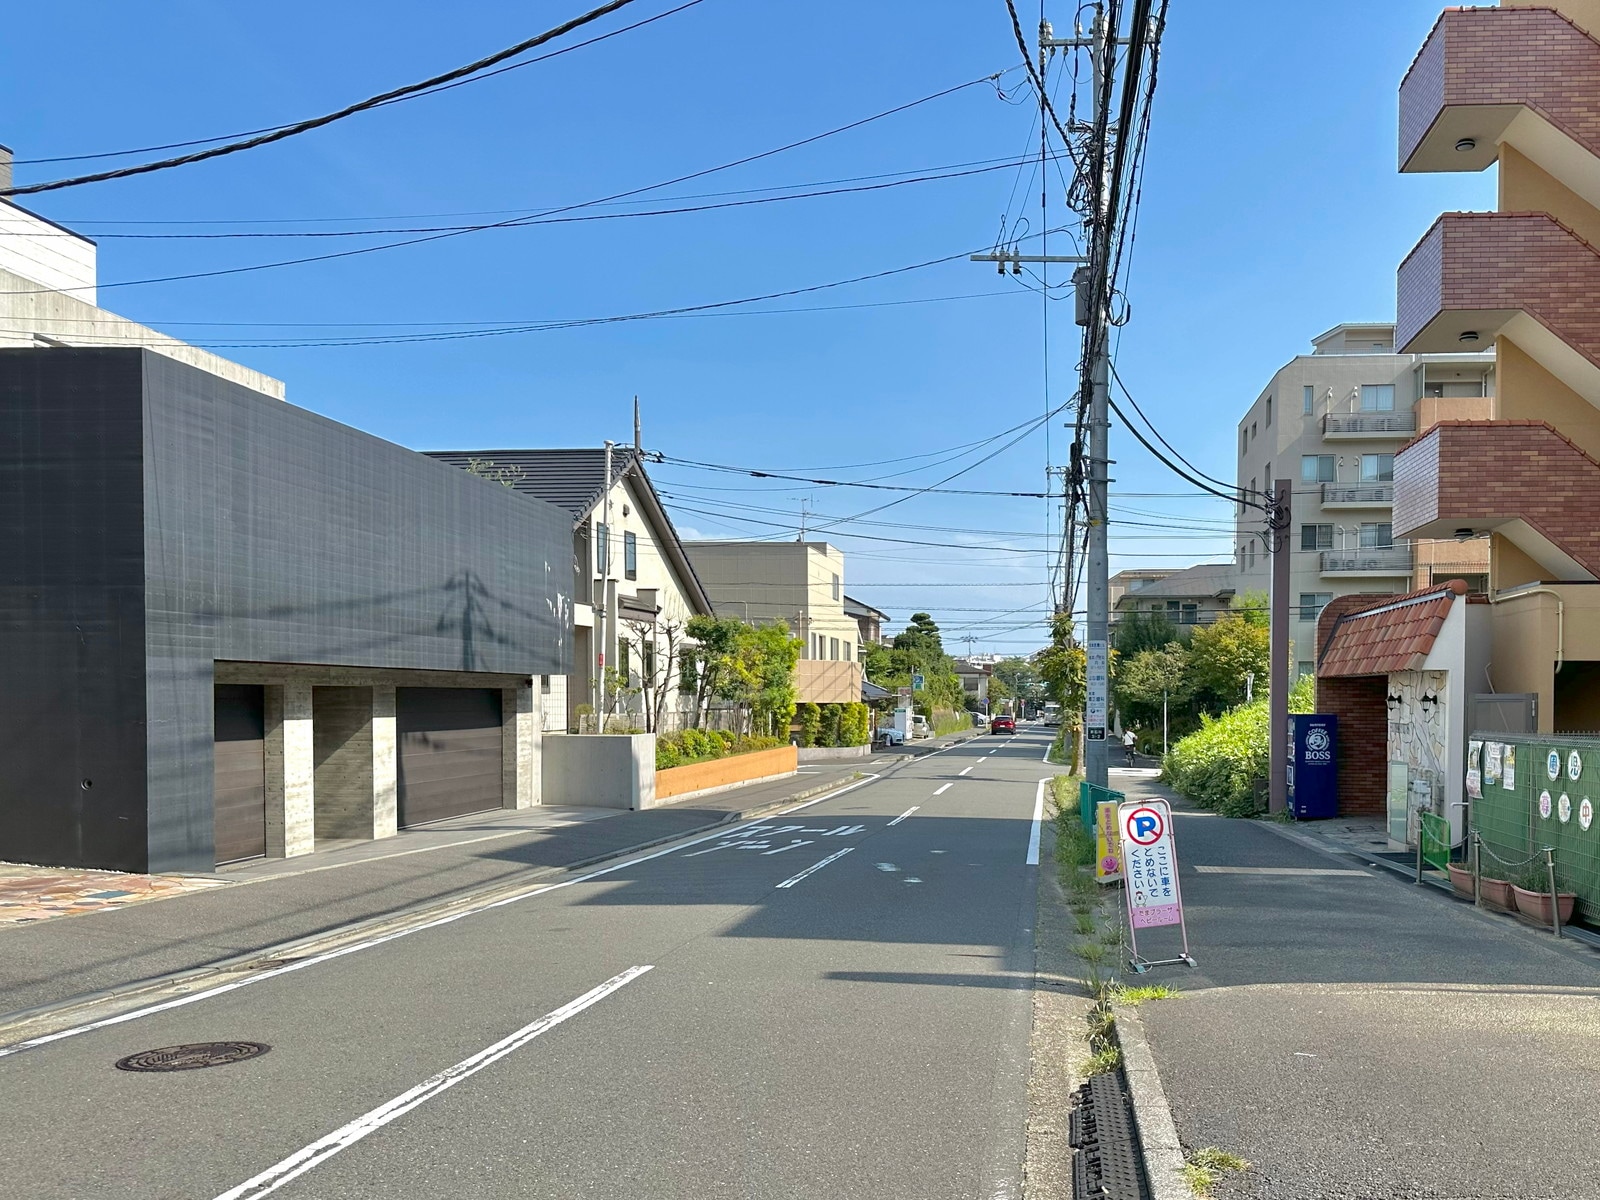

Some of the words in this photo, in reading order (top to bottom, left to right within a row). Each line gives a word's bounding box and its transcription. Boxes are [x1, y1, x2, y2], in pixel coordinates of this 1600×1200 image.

[1305, 751, 1331, 760] BOSS
[721, 824, 867, 839] スクール
[1135, 816, 1156, 837] P
[681, 839, 815, 857] ゾーン
[1131, 849, 1145, 889] ください
[1157, 846, 1172, 897] ここに車を
